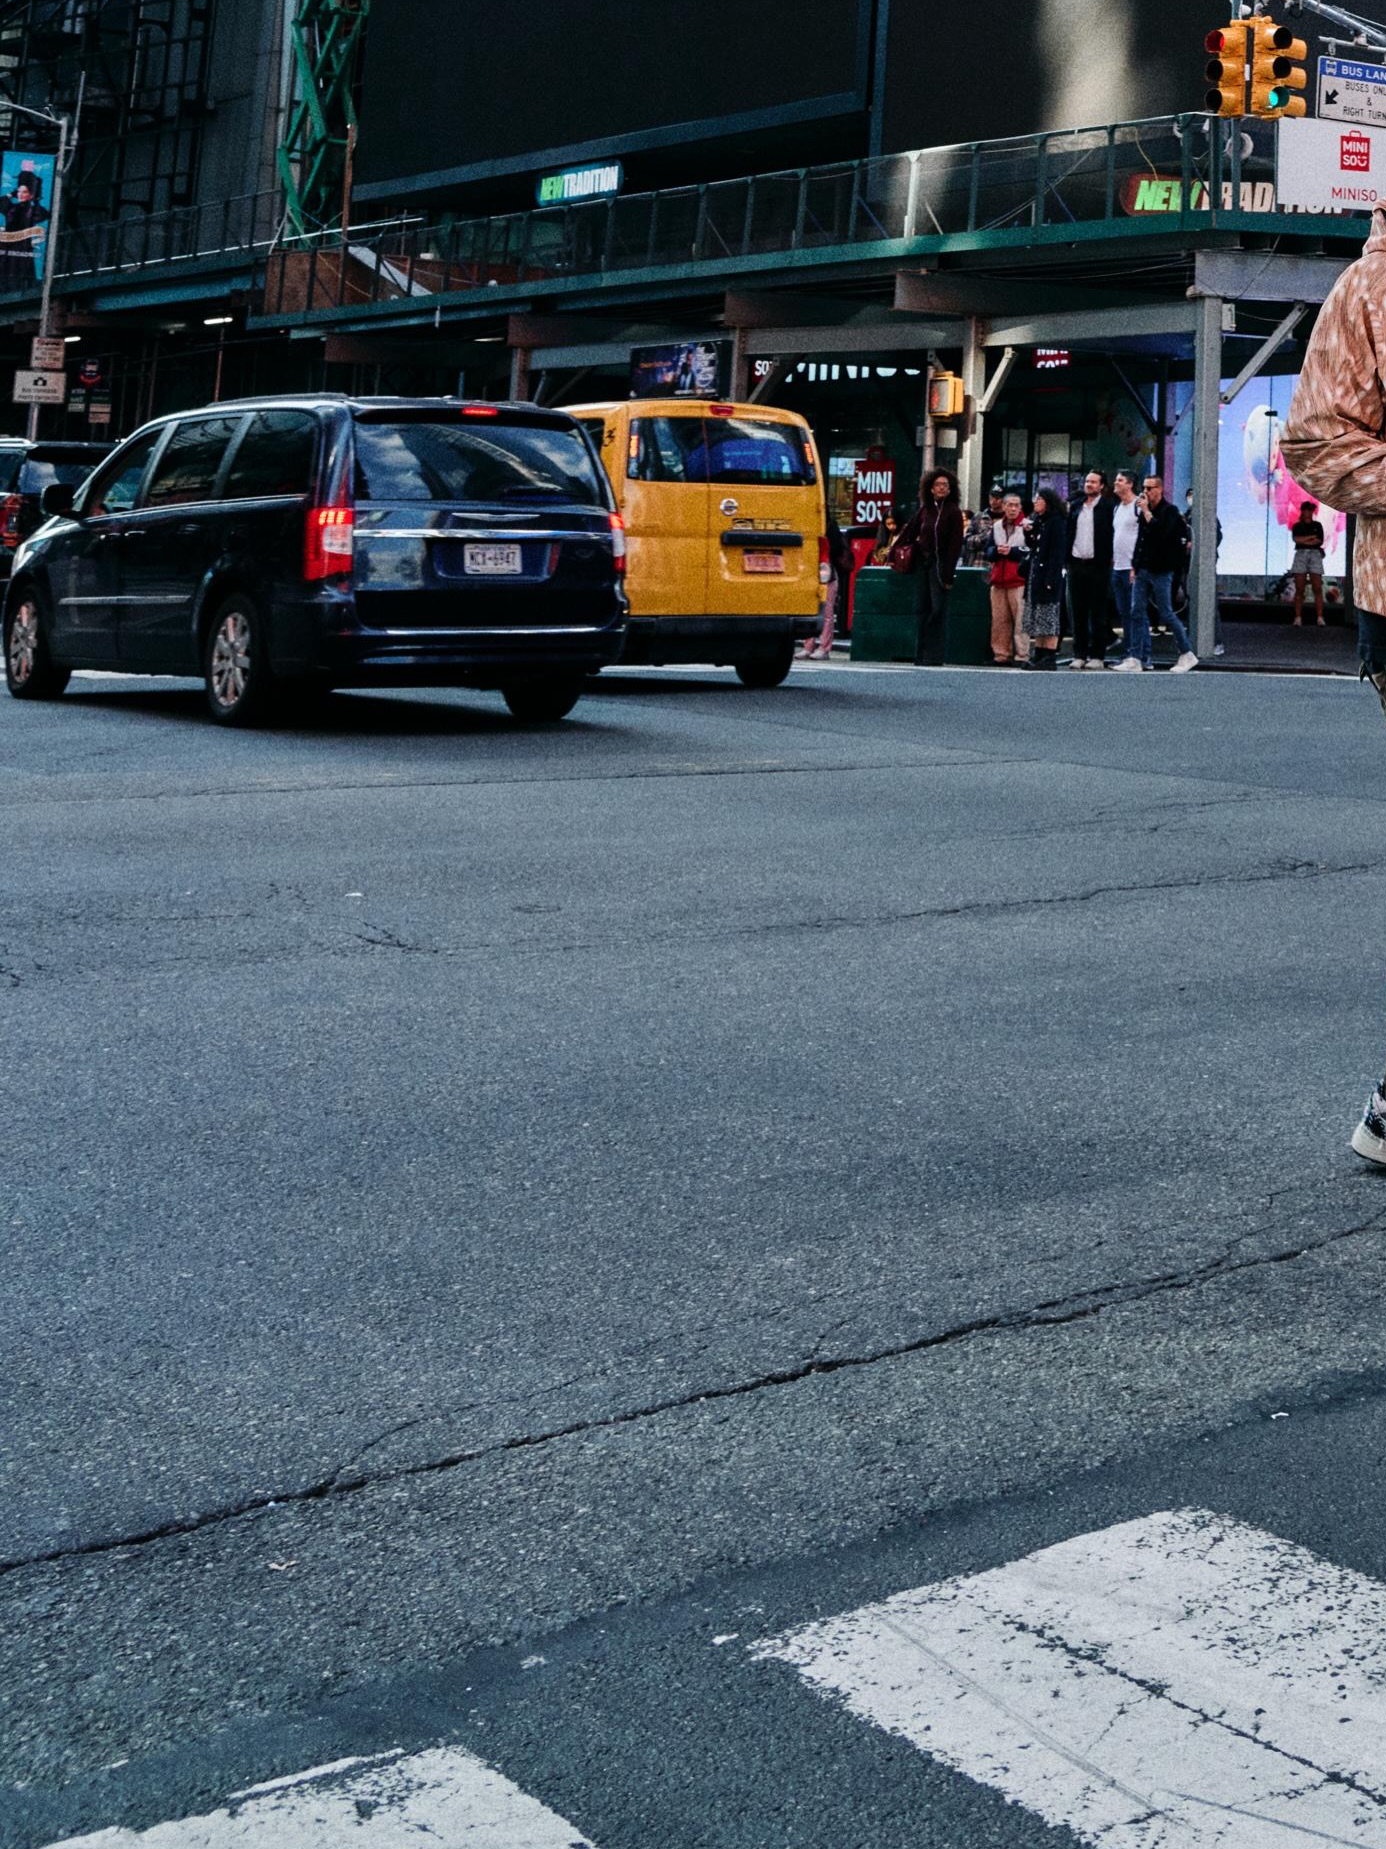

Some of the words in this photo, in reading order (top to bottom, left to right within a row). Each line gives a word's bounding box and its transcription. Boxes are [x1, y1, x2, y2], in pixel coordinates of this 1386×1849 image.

[1341, 65, 1363, 77] BUS
[1345, 81, 1369, 93] BUSES
[1343, 106, 1364, 117] RIGHT
[1343, 141, 1368, 153] MINI
[1332, 187, 1377, 202] MINISO
[857, 471, 892, 494] MINI
